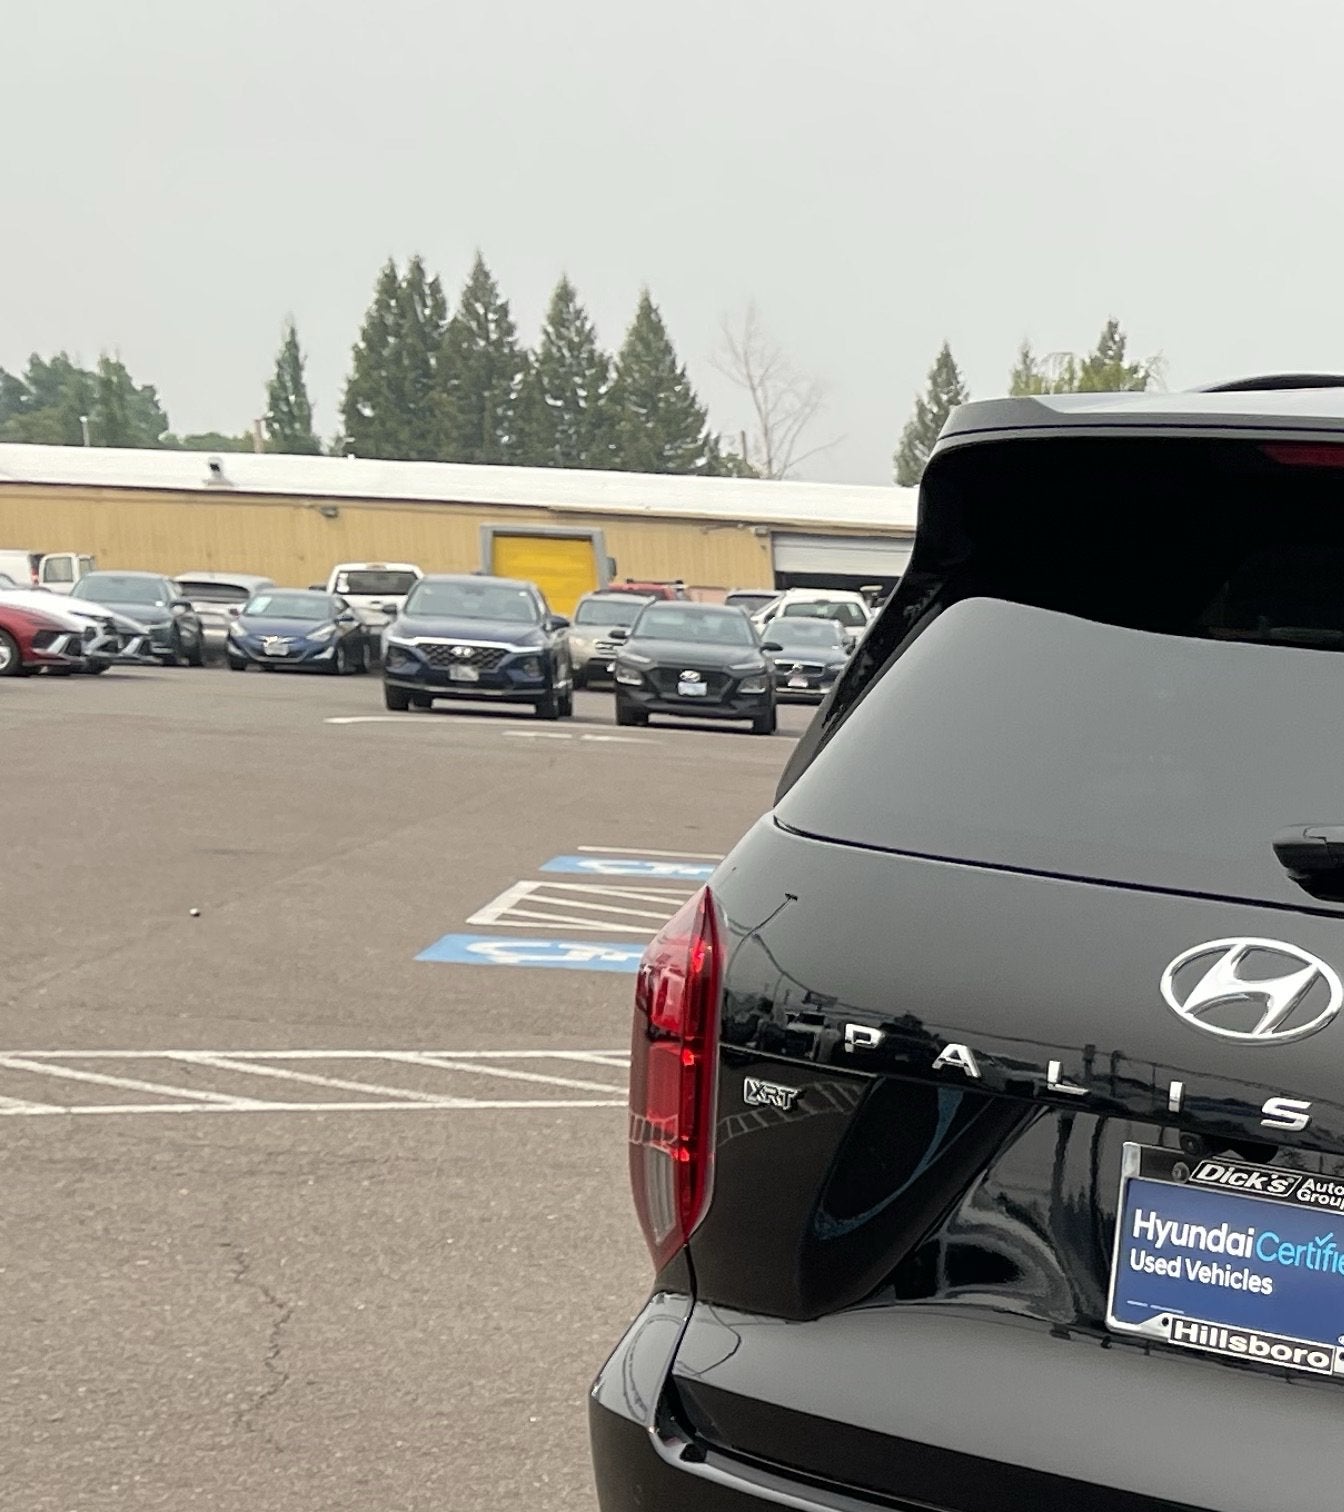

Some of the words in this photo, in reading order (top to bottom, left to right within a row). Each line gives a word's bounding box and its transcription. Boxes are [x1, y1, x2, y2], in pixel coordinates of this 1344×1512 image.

[744, 1077, 799, 1110] XRT
[1196, 1163, 1292, 1194] Dick's
[1132, 1209, 1255, 1258] Hyundai
[1130, 1248, 1182, 1278] Used
[1185, 1259, 1273, 1295] Vehicles
[1174, 1320, 1330, 1368] Hillsboro
